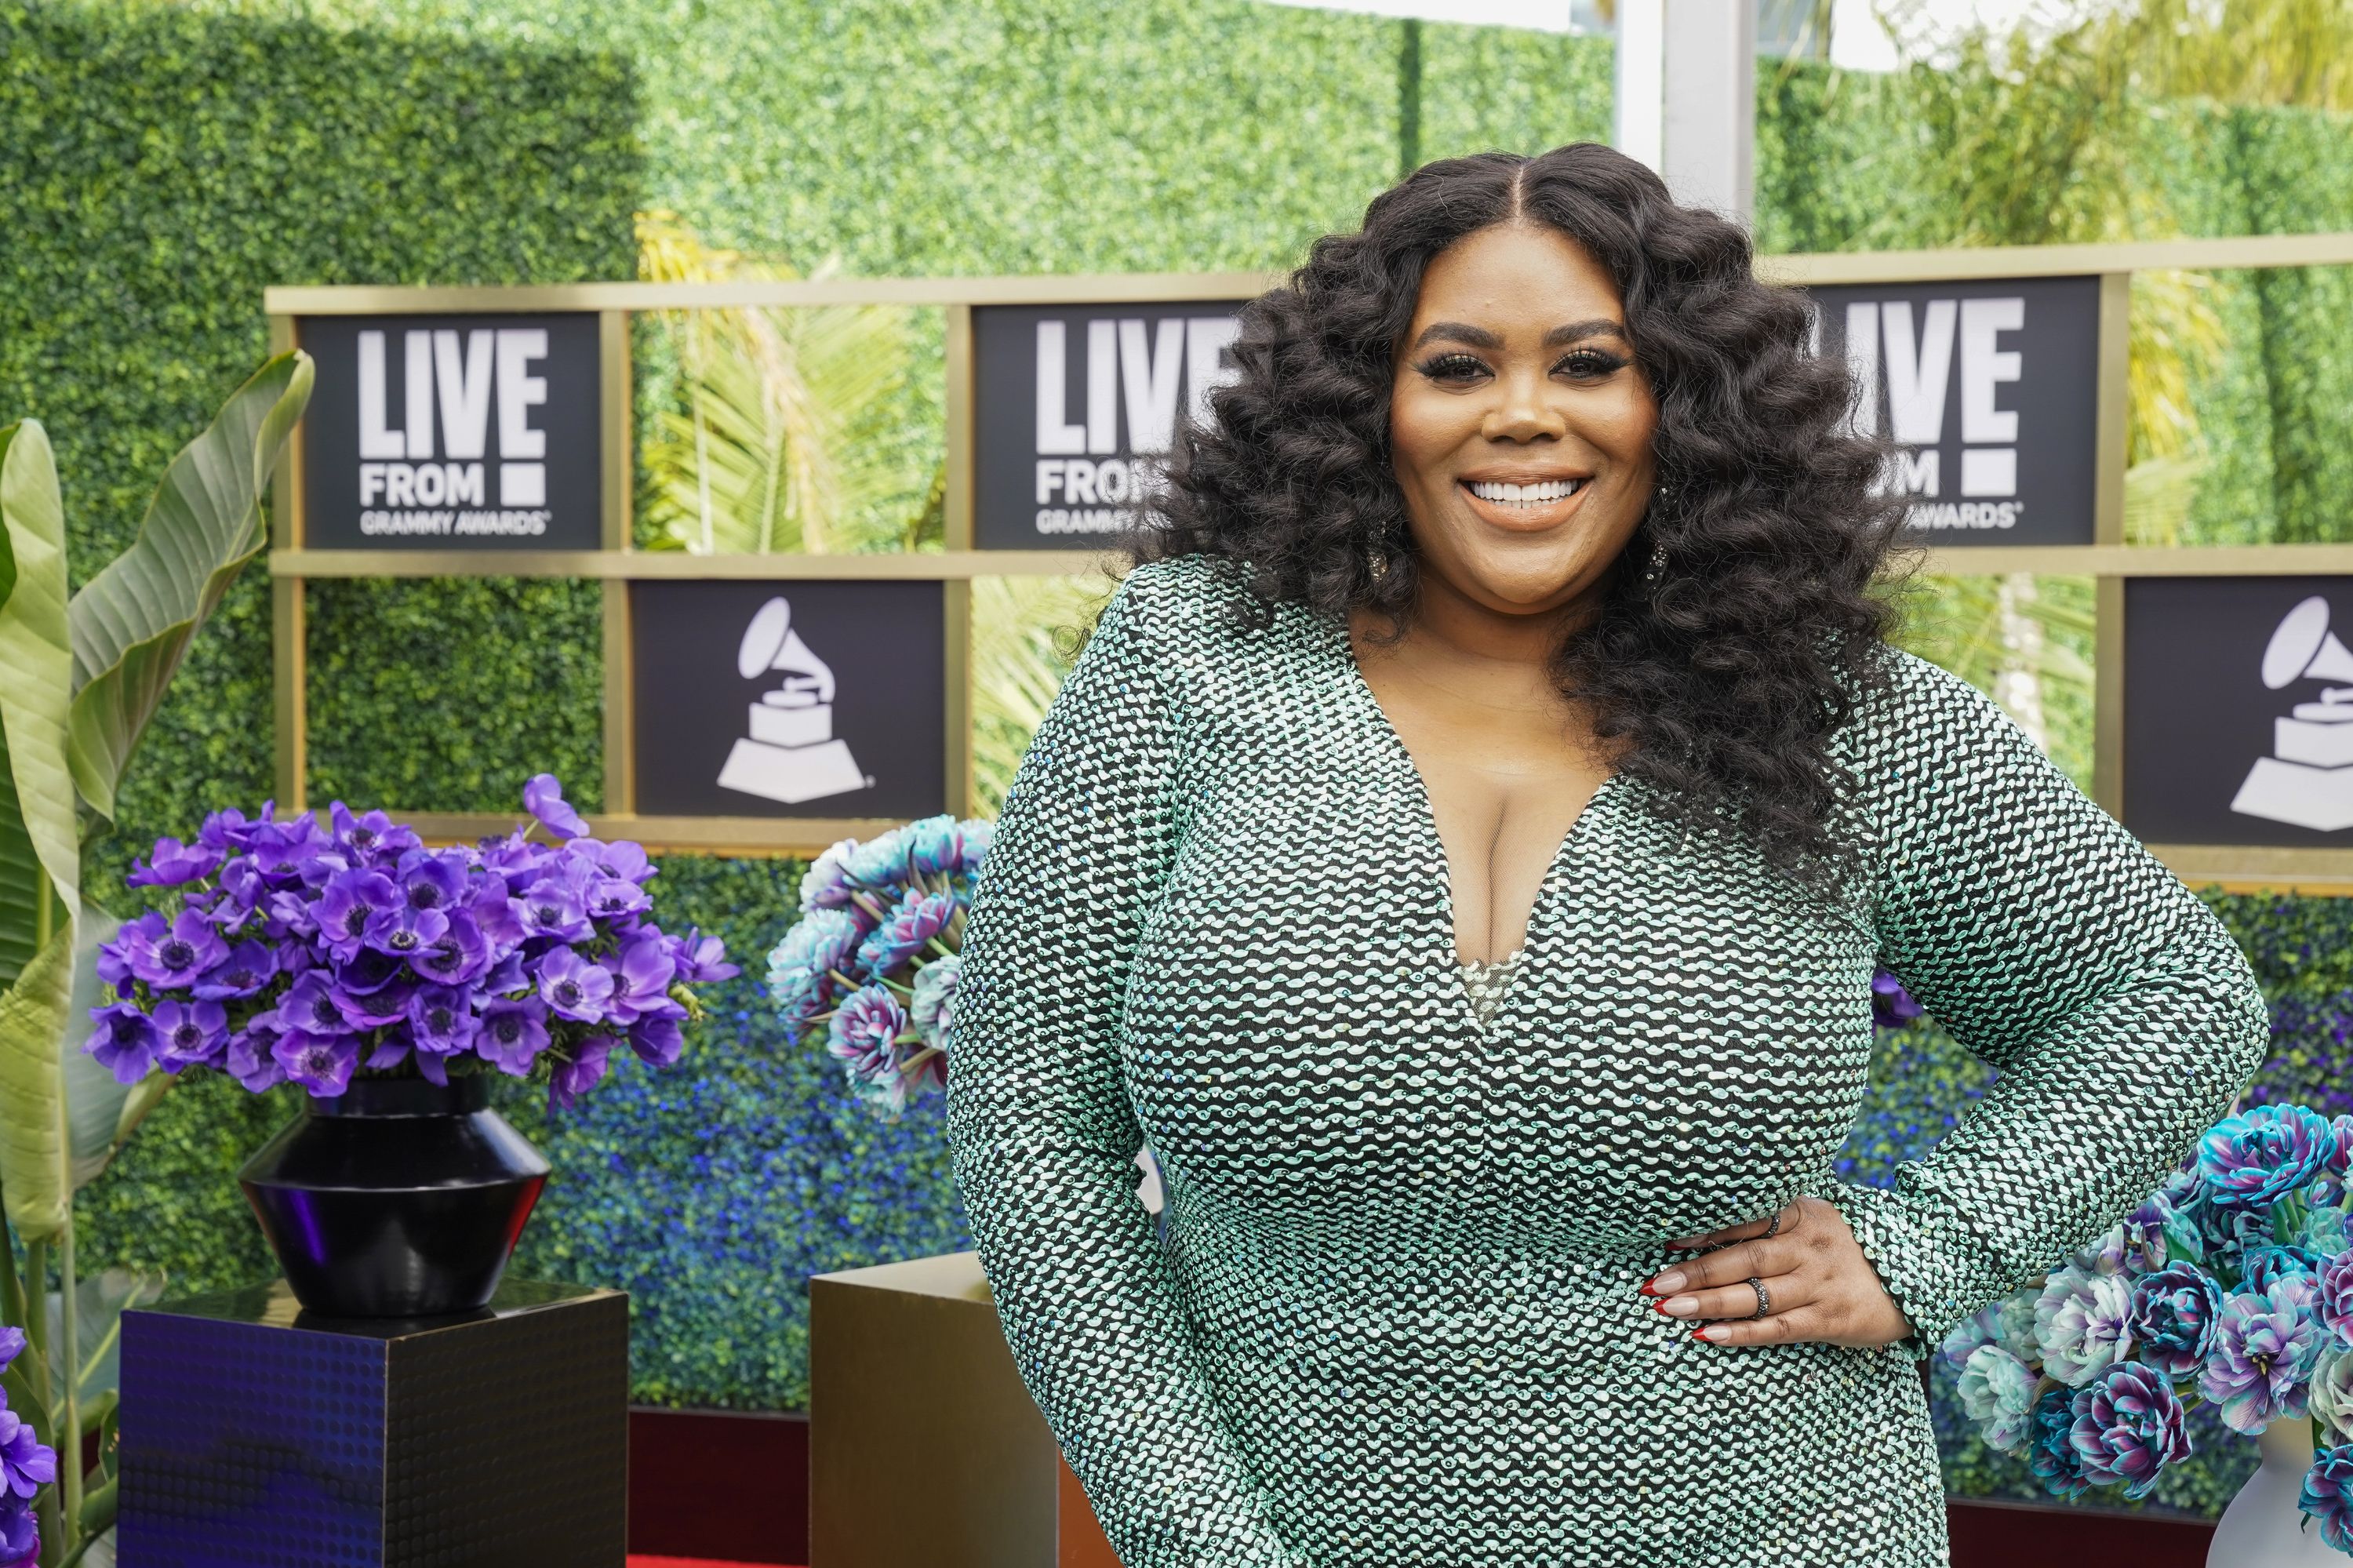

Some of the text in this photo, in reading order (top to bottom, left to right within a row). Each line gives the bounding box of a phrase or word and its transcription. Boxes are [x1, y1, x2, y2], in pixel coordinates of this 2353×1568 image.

[358, 329, 547, 459] LIVE
[1796, 298, 2024, 444] IVE
[359, 463, 485, 507] FROM
[359, 511, 455, 535] GRAMMY
